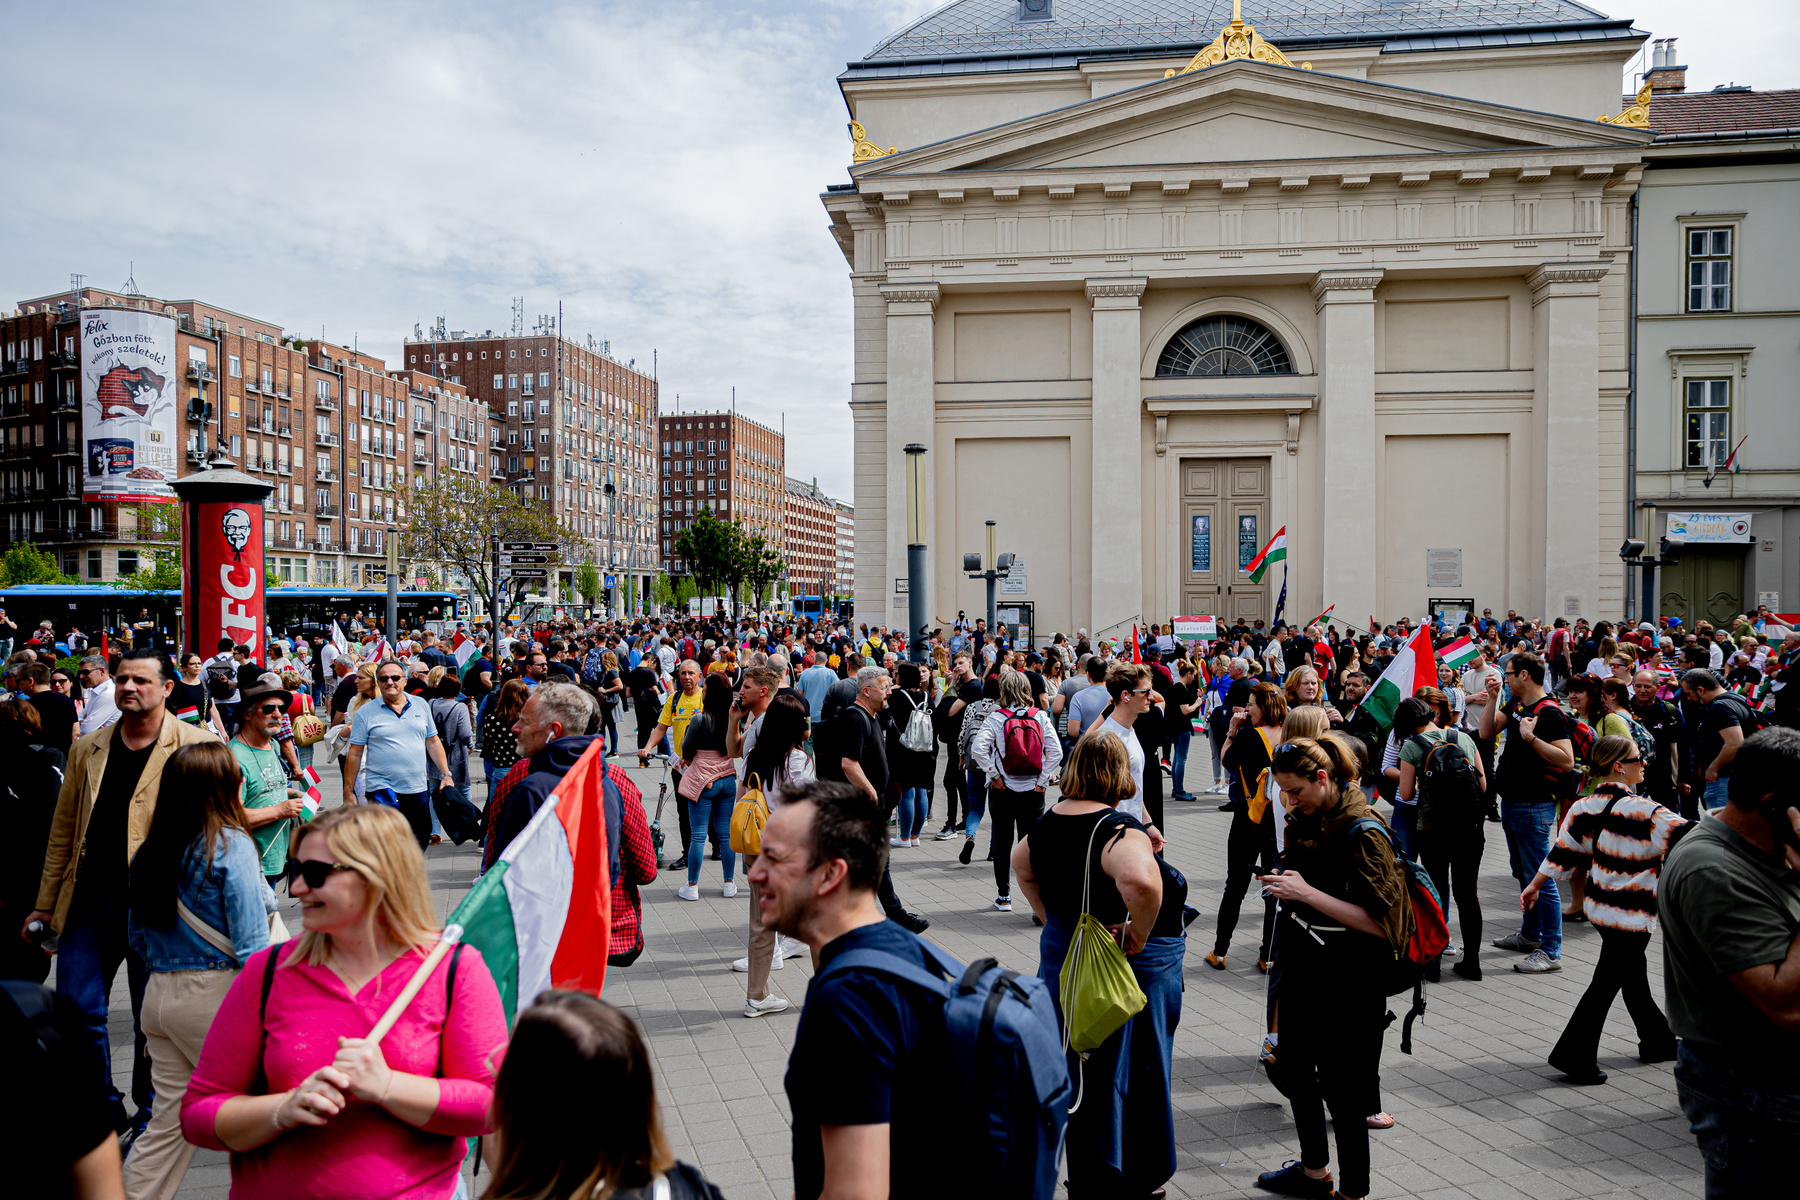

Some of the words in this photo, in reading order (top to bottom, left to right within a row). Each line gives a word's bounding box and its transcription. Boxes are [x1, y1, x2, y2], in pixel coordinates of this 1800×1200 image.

[84, 320, 109, 339] felix
[93, 333, 132, 348] Gőzben
[134, 334, 155, 345] főtt,
[91, 348, 114, 365] vékony
[117, 345, 166, 366] szeletek!
[138, 452, 172, 466] SLICED
[1688, 513, 1700, 523] 25
[1703, 514, 1722, 522] ÉVES
[1694, 522, 1726, 533] KISDEÁK
